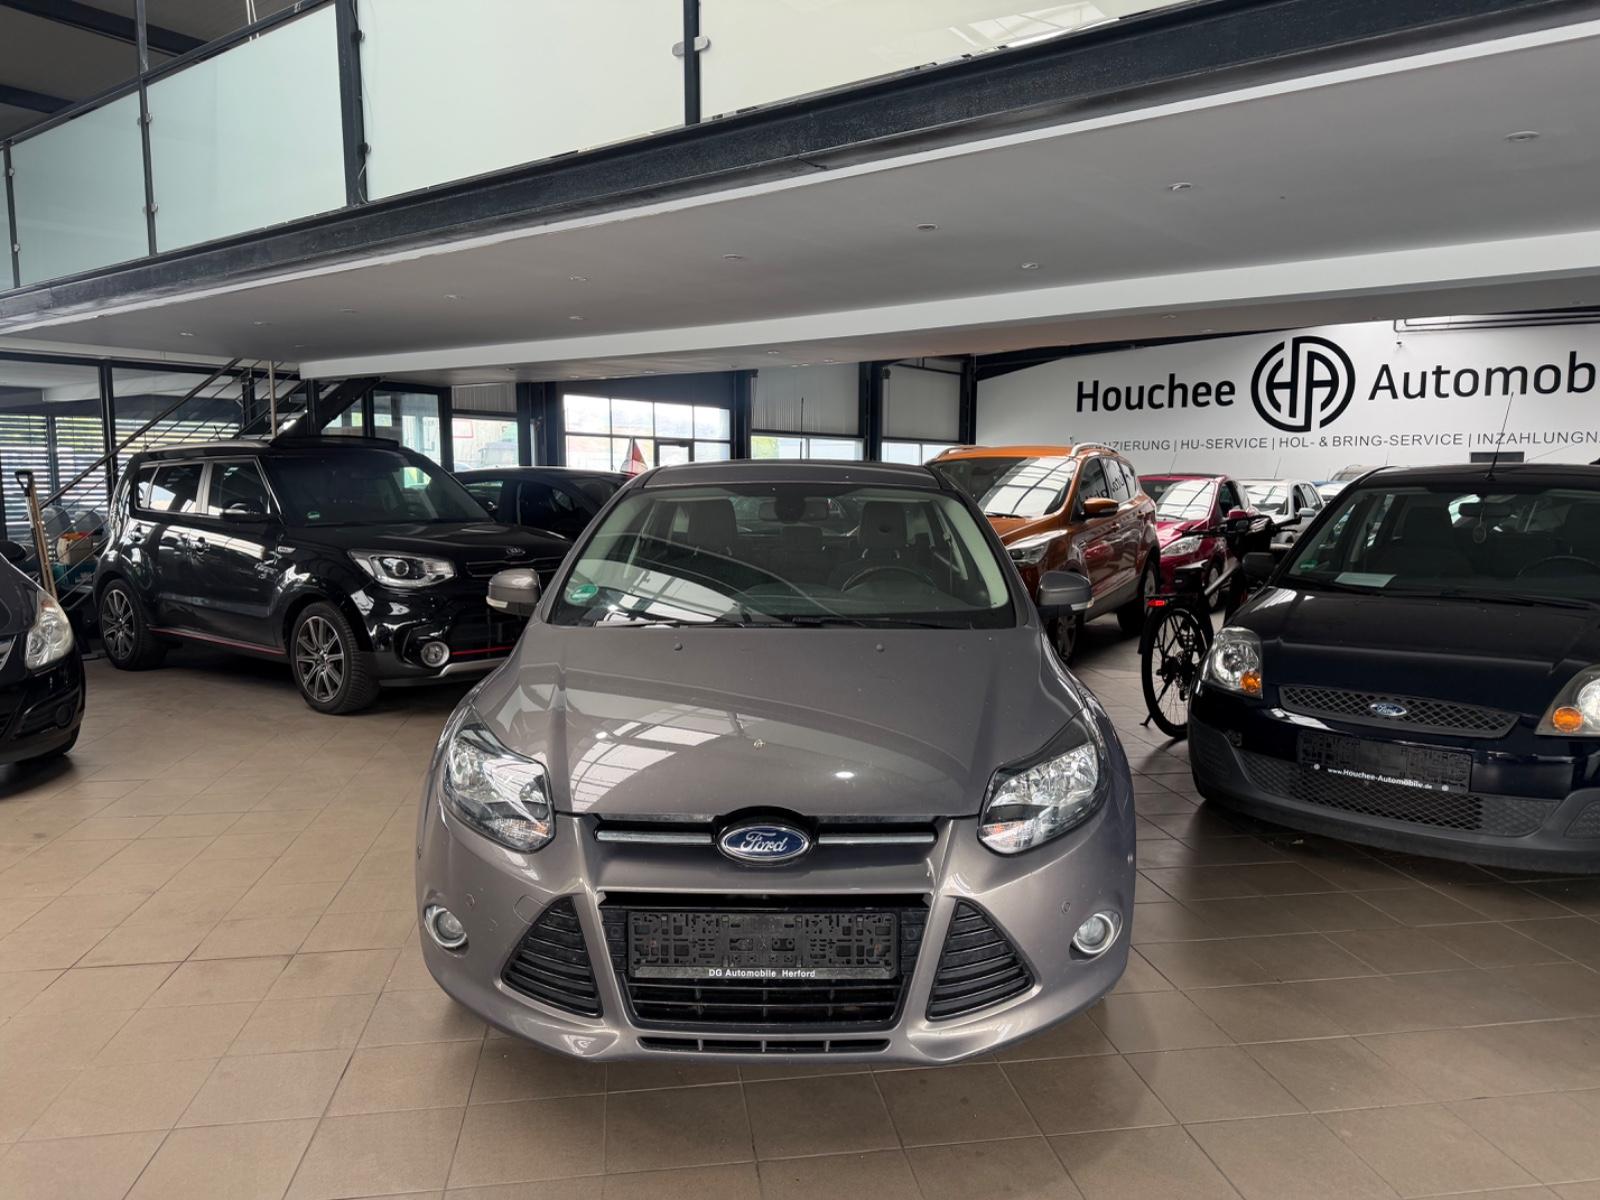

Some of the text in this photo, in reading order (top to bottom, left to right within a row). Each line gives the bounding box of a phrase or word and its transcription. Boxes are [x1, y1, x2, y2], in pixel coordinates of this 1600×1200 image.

[1076, 373, 1236, 413] Houchee
[1368, 351, 1597, 401] Automob
[1075, 439, 1170, 452] ZIERUNG
[1180, 437, 1268, 450] HU-SERVICE
[1279, 436, 1315, 448] HOL-
[1318, 436, 1328, 447] &
[1332, 433, 1464, 448] BRING-SERVICE
[1477, 430, 1600, 445] INZAHLUNGN
[740, 831, 788, 852] Ford
[708, 968, 816, 978] DG Automobile Herford
